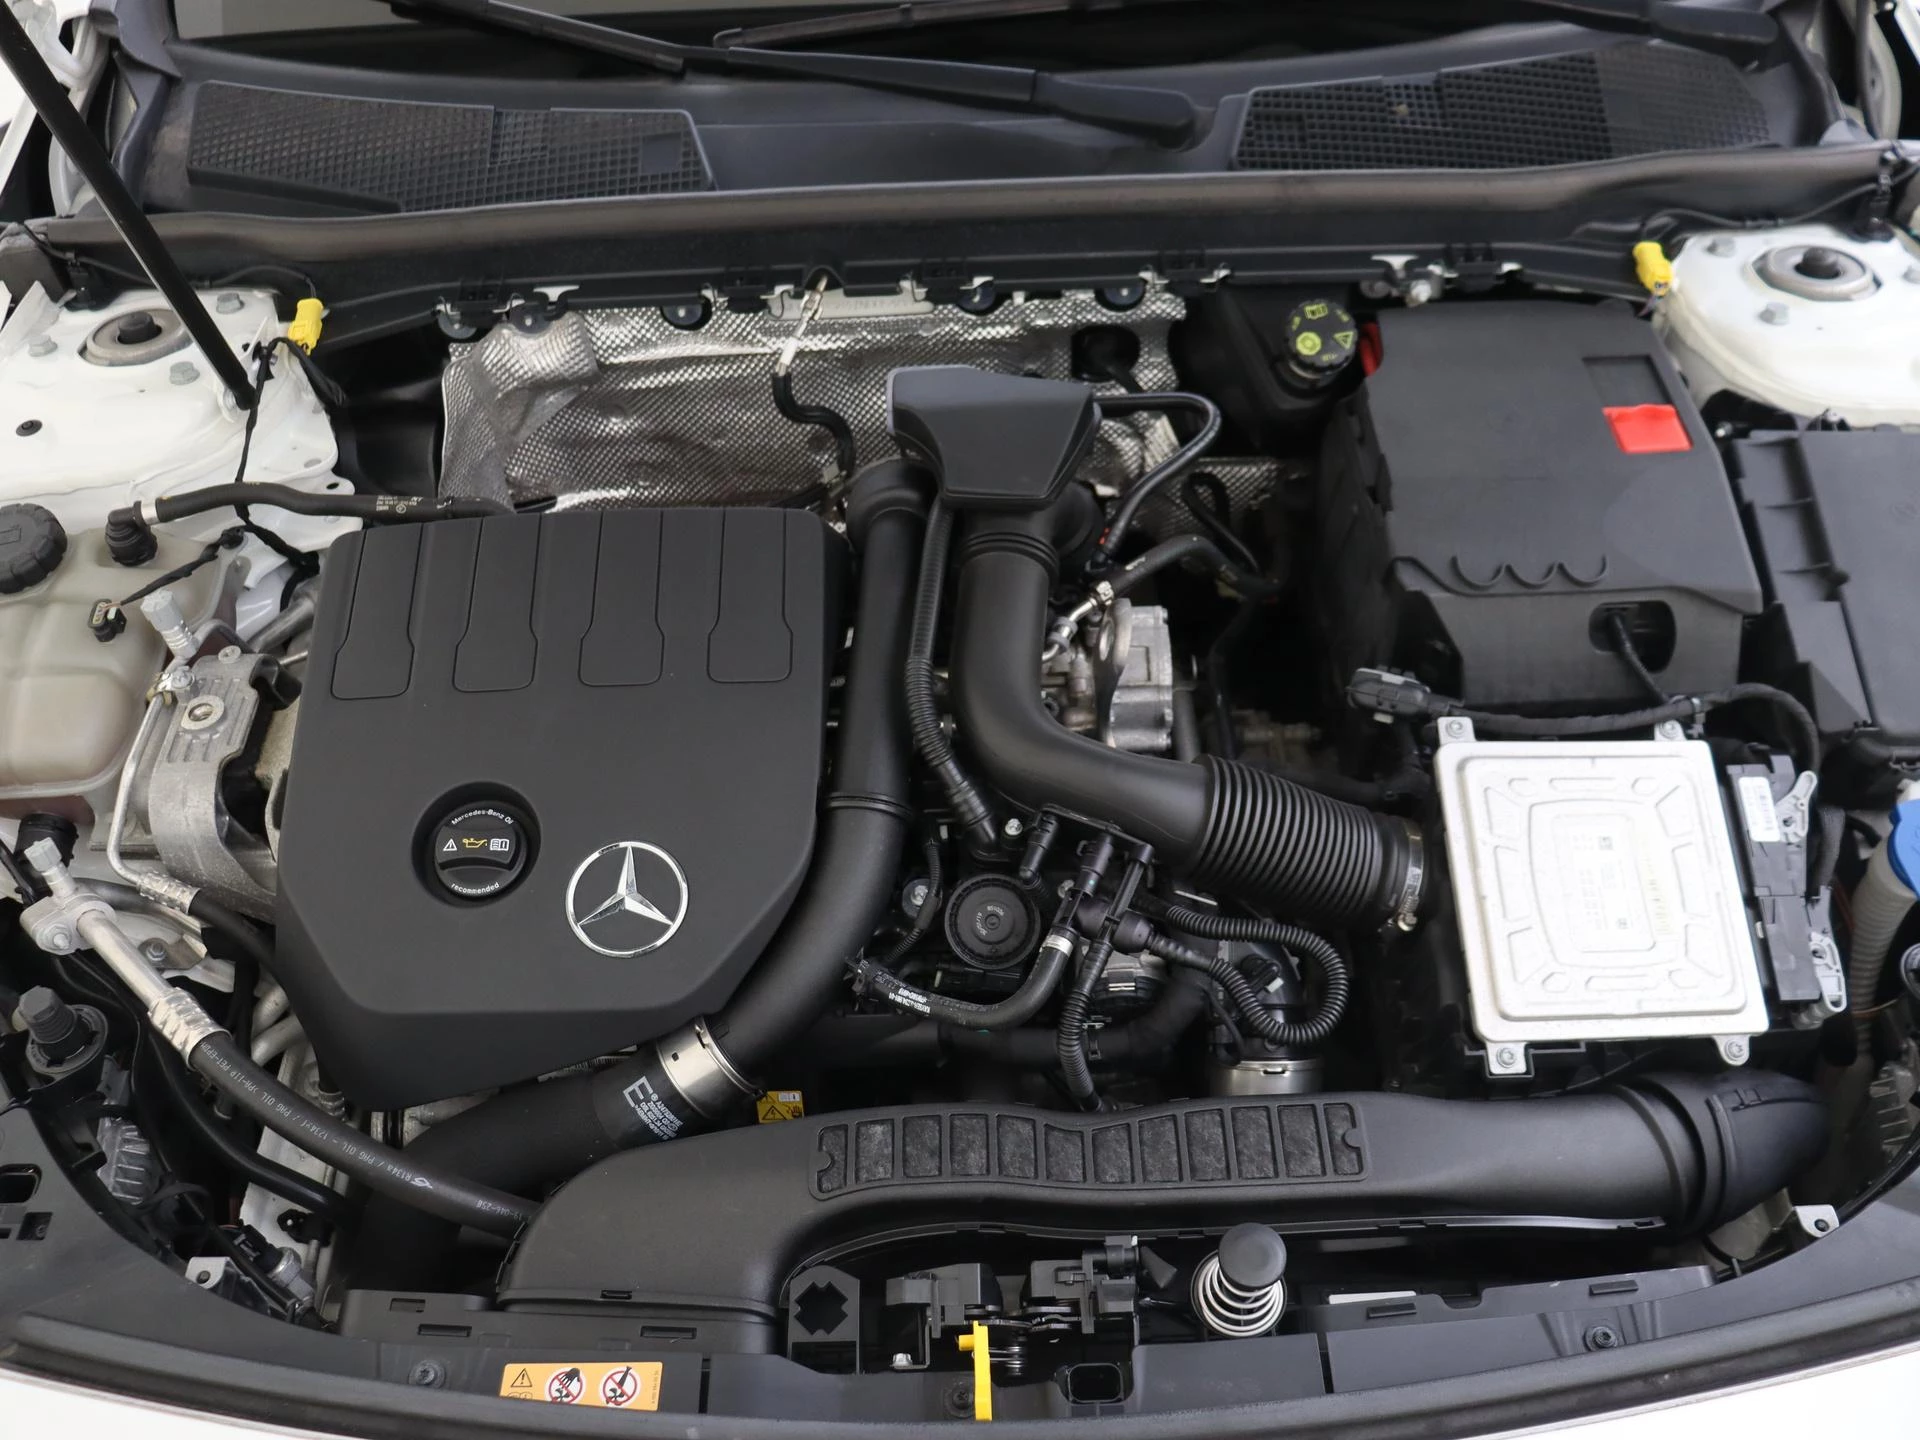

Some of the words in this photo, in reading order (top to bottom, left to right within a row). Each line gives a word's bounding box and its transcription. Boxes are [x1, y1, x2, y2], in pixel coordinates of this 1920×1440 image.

[451, 809, 504, 825] Mercedes-Benz
[451, 882, 500, 894] recommended
[261, 1091, 276, 1106] OIL
[623, 1076, 653, 1107] E
[276, 1103, 292, 1117] PAG
[342, 1143, 357, 1155] OIL
[359, 1151, 376, 1165] PAG
[387, 1165, 413, 1182] R134a
